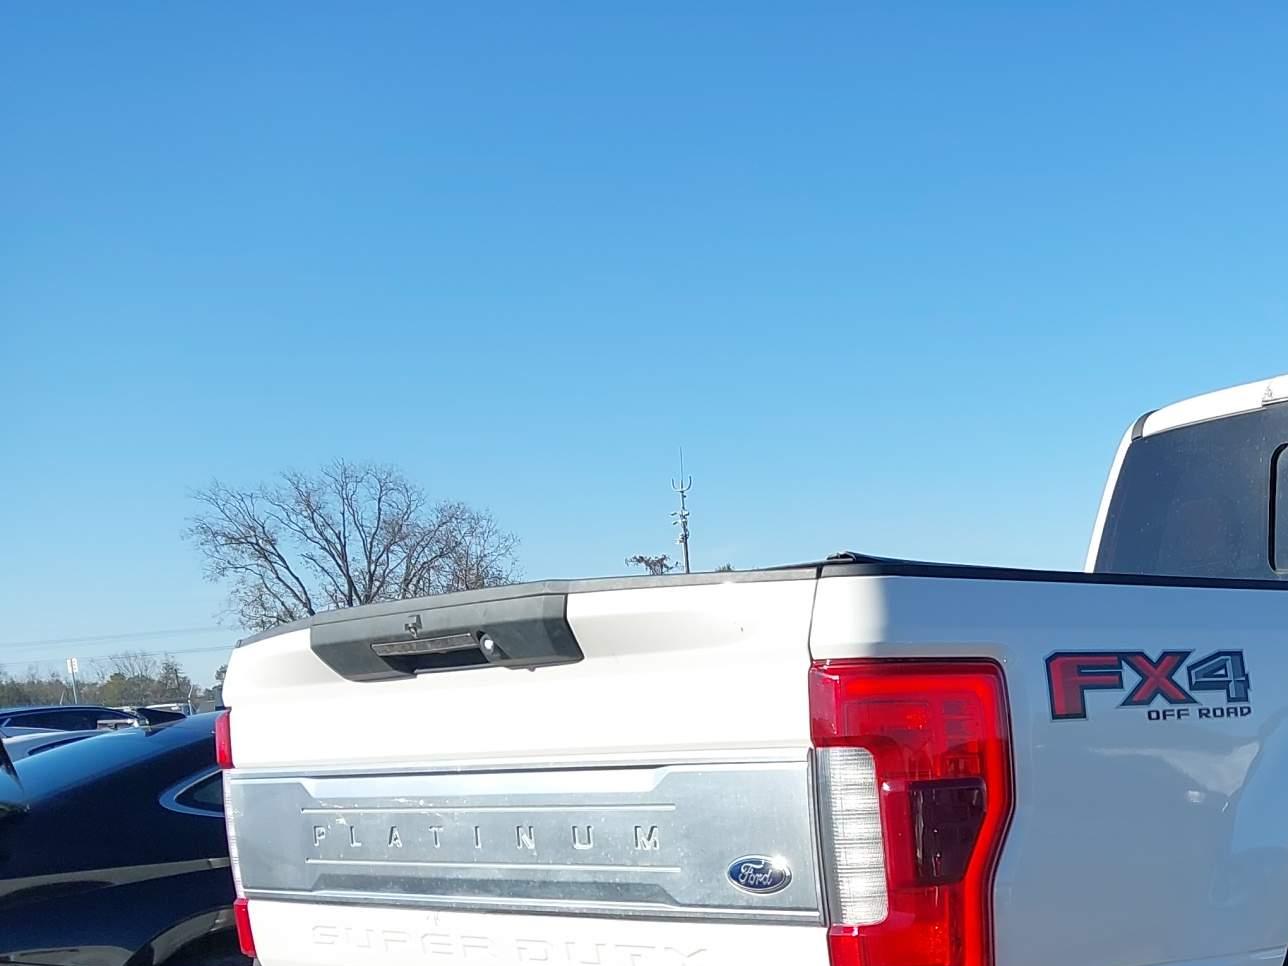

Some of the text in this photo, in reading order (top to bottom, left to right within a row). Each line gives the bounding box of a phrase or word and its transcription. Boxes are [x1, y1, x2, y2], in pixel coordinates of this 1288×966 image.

[1045, 650, 1250, 720] FX4
[1147, 706, 1252, 721] OFF ROAD
[312, 824, 661, 850] PLATINUM
[738, 859, 773, 886] Ford
[311, 924, 496, 958] SUPER
